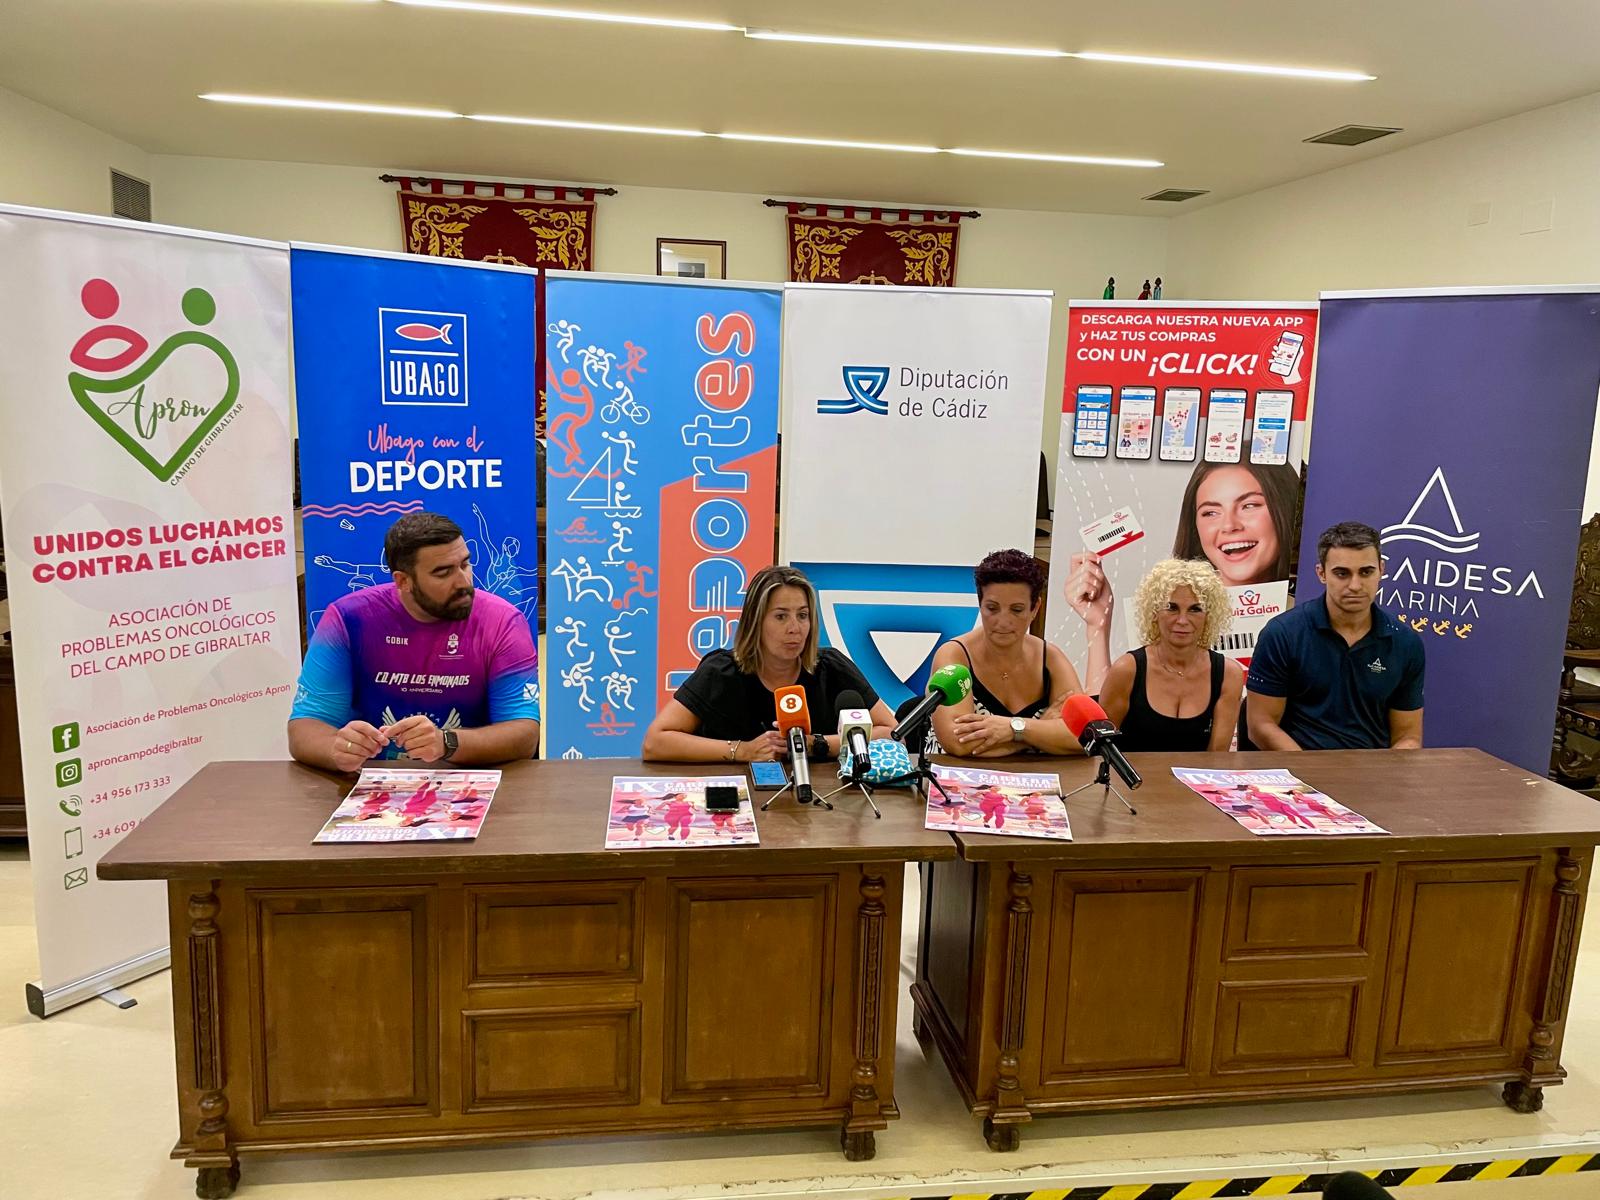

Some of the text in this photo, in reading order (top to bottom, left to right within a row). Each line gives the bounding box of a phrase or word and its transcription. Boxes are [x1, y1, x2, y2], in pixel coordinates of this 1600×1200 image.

[1081, 314, 1304, 327] DESCARGA NUESTRA NUEVA APP
[1080, 330, 1217, 343] y HAZ TUS COMPRAS
[1076, 348, 1258, 377] CON UN ¡CLICK!
[389, 360, 460, 397] UBAGO
[900, 367, 1009, 391] Diputación
[107, 383, 210, 440] Apron
[898, 397, 988, 419] de Cádiz
[170, 403, 244, 487] CAMPO DE GIBRALTAR
[368, 422, 485, 465] Ubago con el
[349, 458, 503, 493] DEPORTE
[33, 515, 284, 556] UNIDOS LUCHAMOS
[32, 538, 286, 584] CONTRA EL CÁNCER
[108, 597, 233, 628] ASOCIACIÓN DE
[1246, 604, 1280, 615] Galán
[61, 610, 276, 658] PROBLEMAS ONCOLÓGICOS
[385, 635, 409, 646] GOBIK
[71, 630, 271, 679] DEL CAMPO DE GIBRALTAR
[388, 672, 410, 686] MTB
[410, 673, 427, 685] LOS
[86, 683, 291, 736] Asociación de Problemas Oncológicos Apron
[785, 697, 797, 710] 8
[87, 735, 203, 772] aproncampodegibraltar
[90, 775, 171, 804] +34 956 173 333
[92, 820, 136, 839] +34 609
